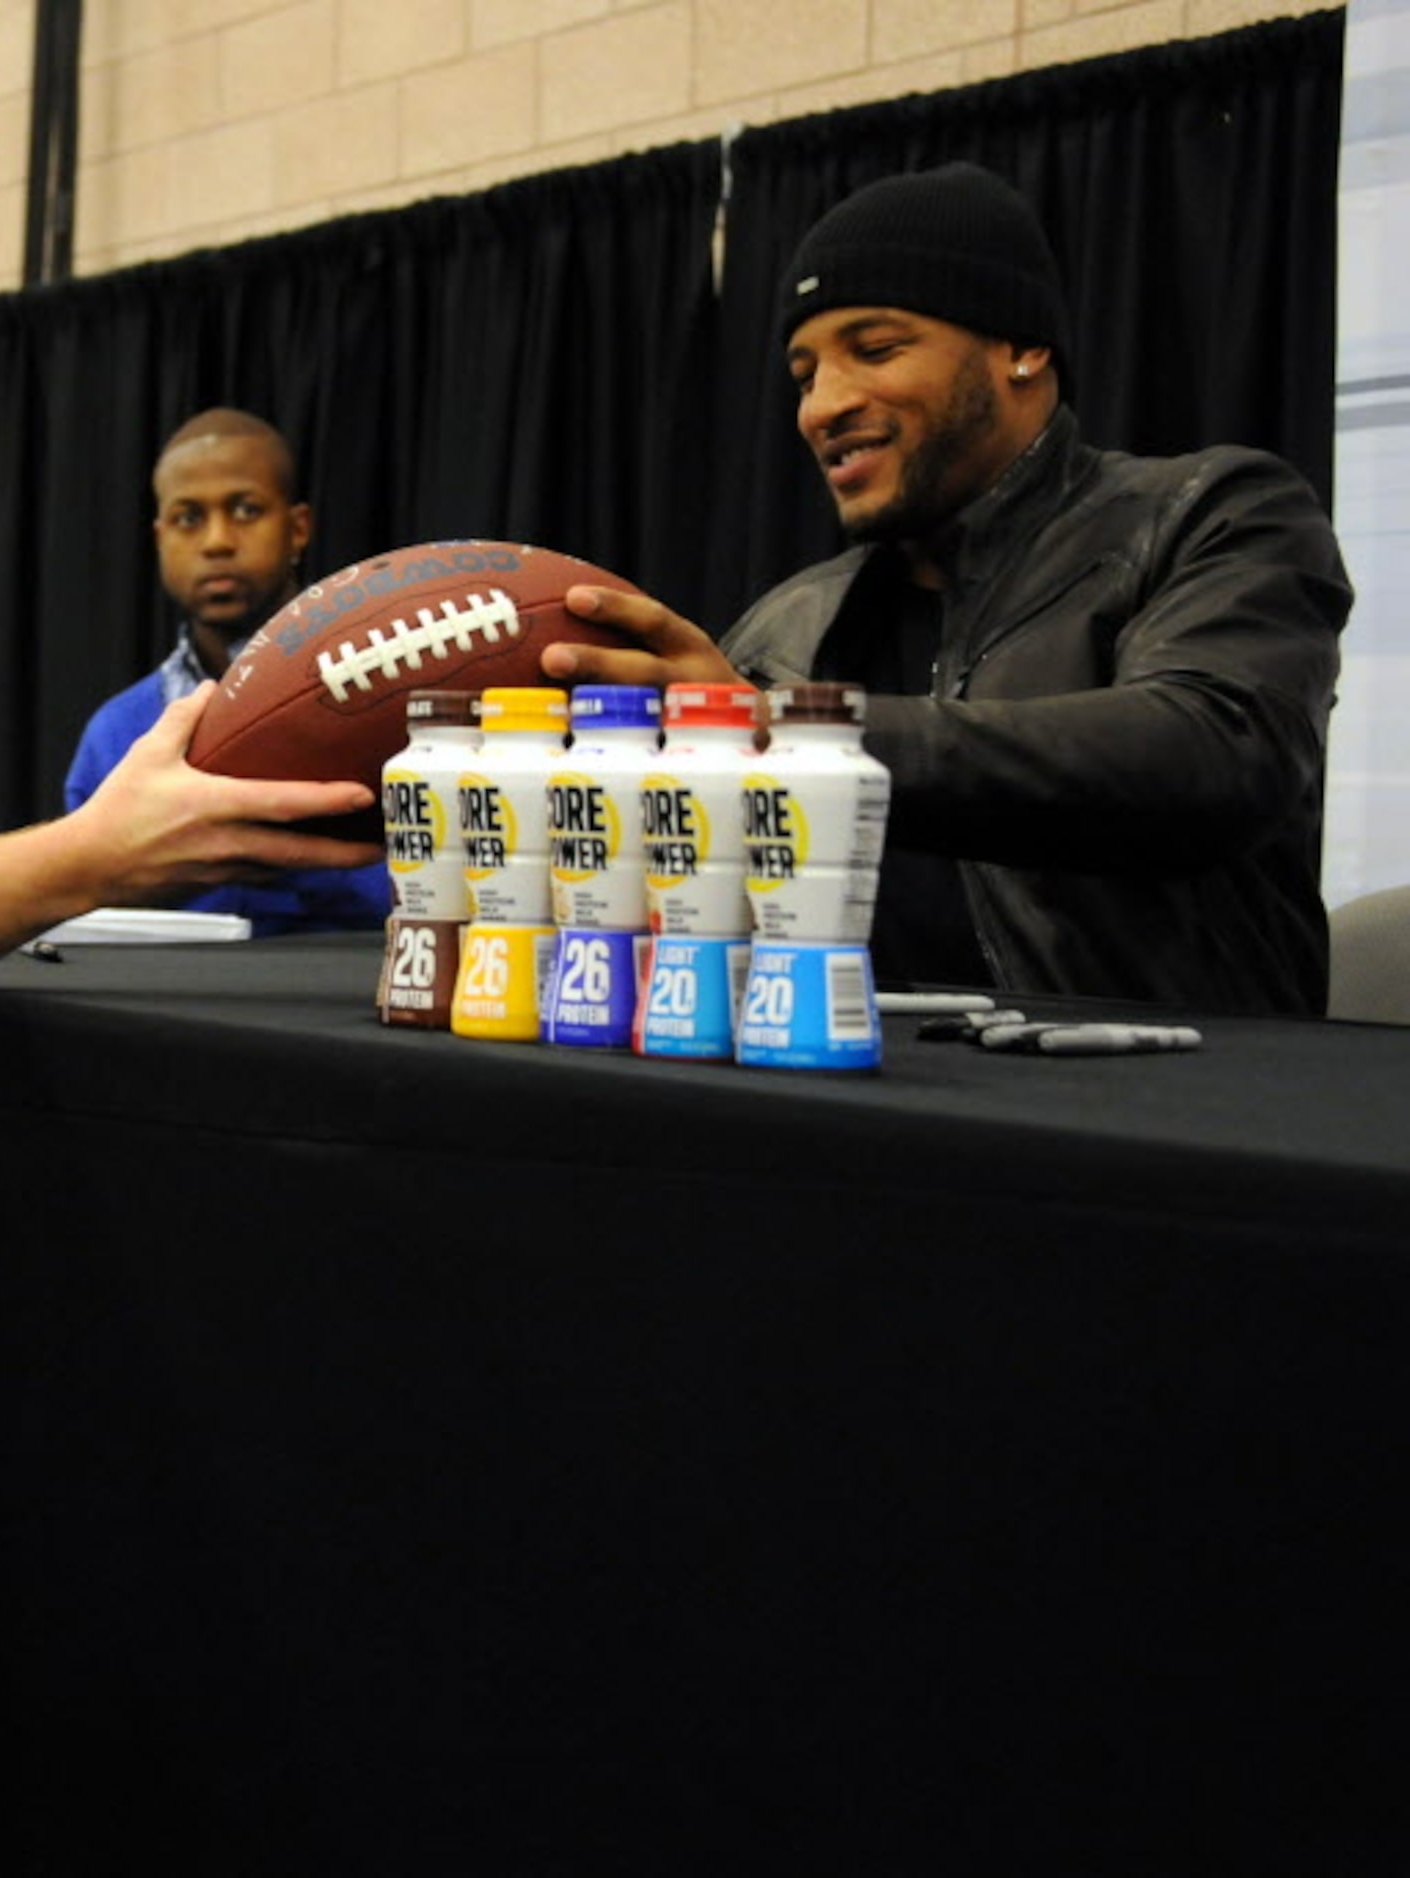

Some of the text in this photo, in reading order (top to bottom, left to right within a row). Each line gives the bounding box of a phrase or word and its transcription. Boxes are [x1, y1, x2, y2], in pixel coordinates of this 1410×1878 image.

[277, 549, 520, 656] COWBOYS
[385, 782, 432, 825] ORE
[546, 787, 606, 832] ORE
[640, 789, 694, 836] ORE
[392, 927, 437, 988] 26
[465, 937, 510, 997] 26
[559, 938, 611, 1002] 26
[558, 1003, 611, 1026] PROTEIN
[649, 967, 696, 1016] 20
[746, 974, 794, 1026] 20
